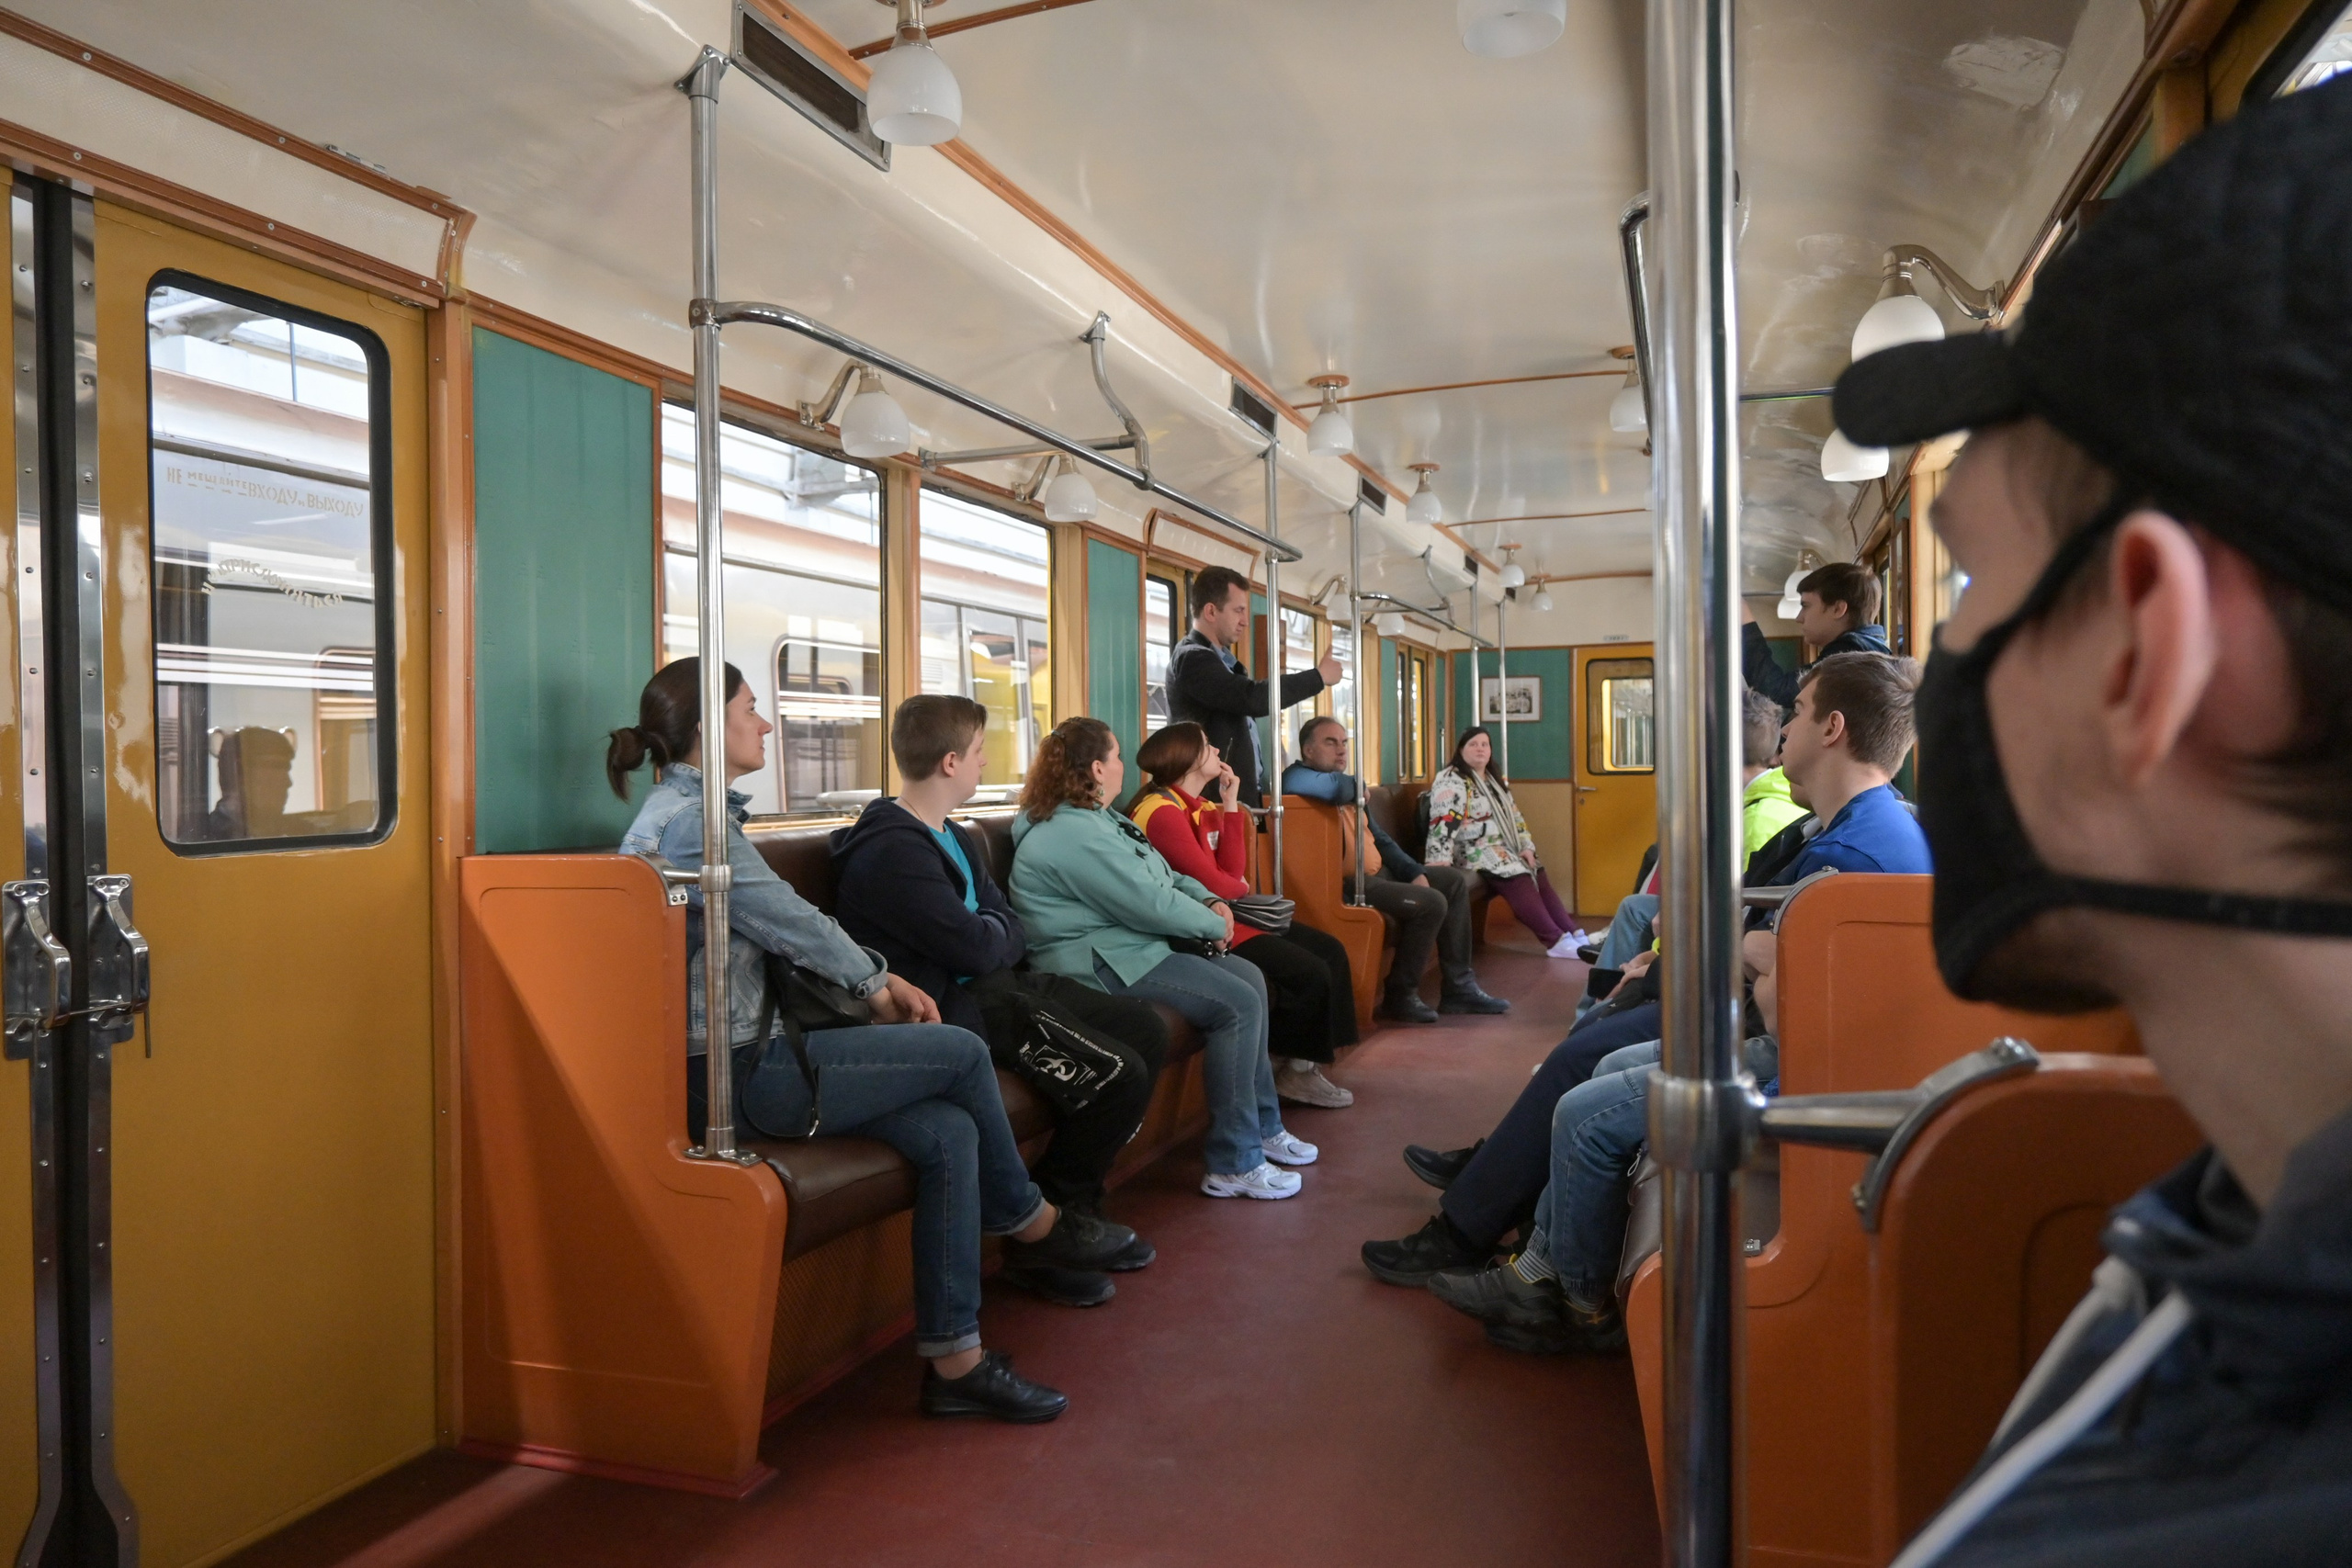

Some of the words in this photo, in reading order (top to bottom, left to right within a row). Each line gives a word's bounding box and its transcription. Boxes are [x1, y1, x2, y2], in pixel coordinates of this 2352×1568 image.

[166, 466, 182, 484] НЕ
[248, 482, 299, 506] ВХОДУ
[307, 492, 364, 519] ВЫХОДУ
[1243, 1170, 1261, 1182] N
